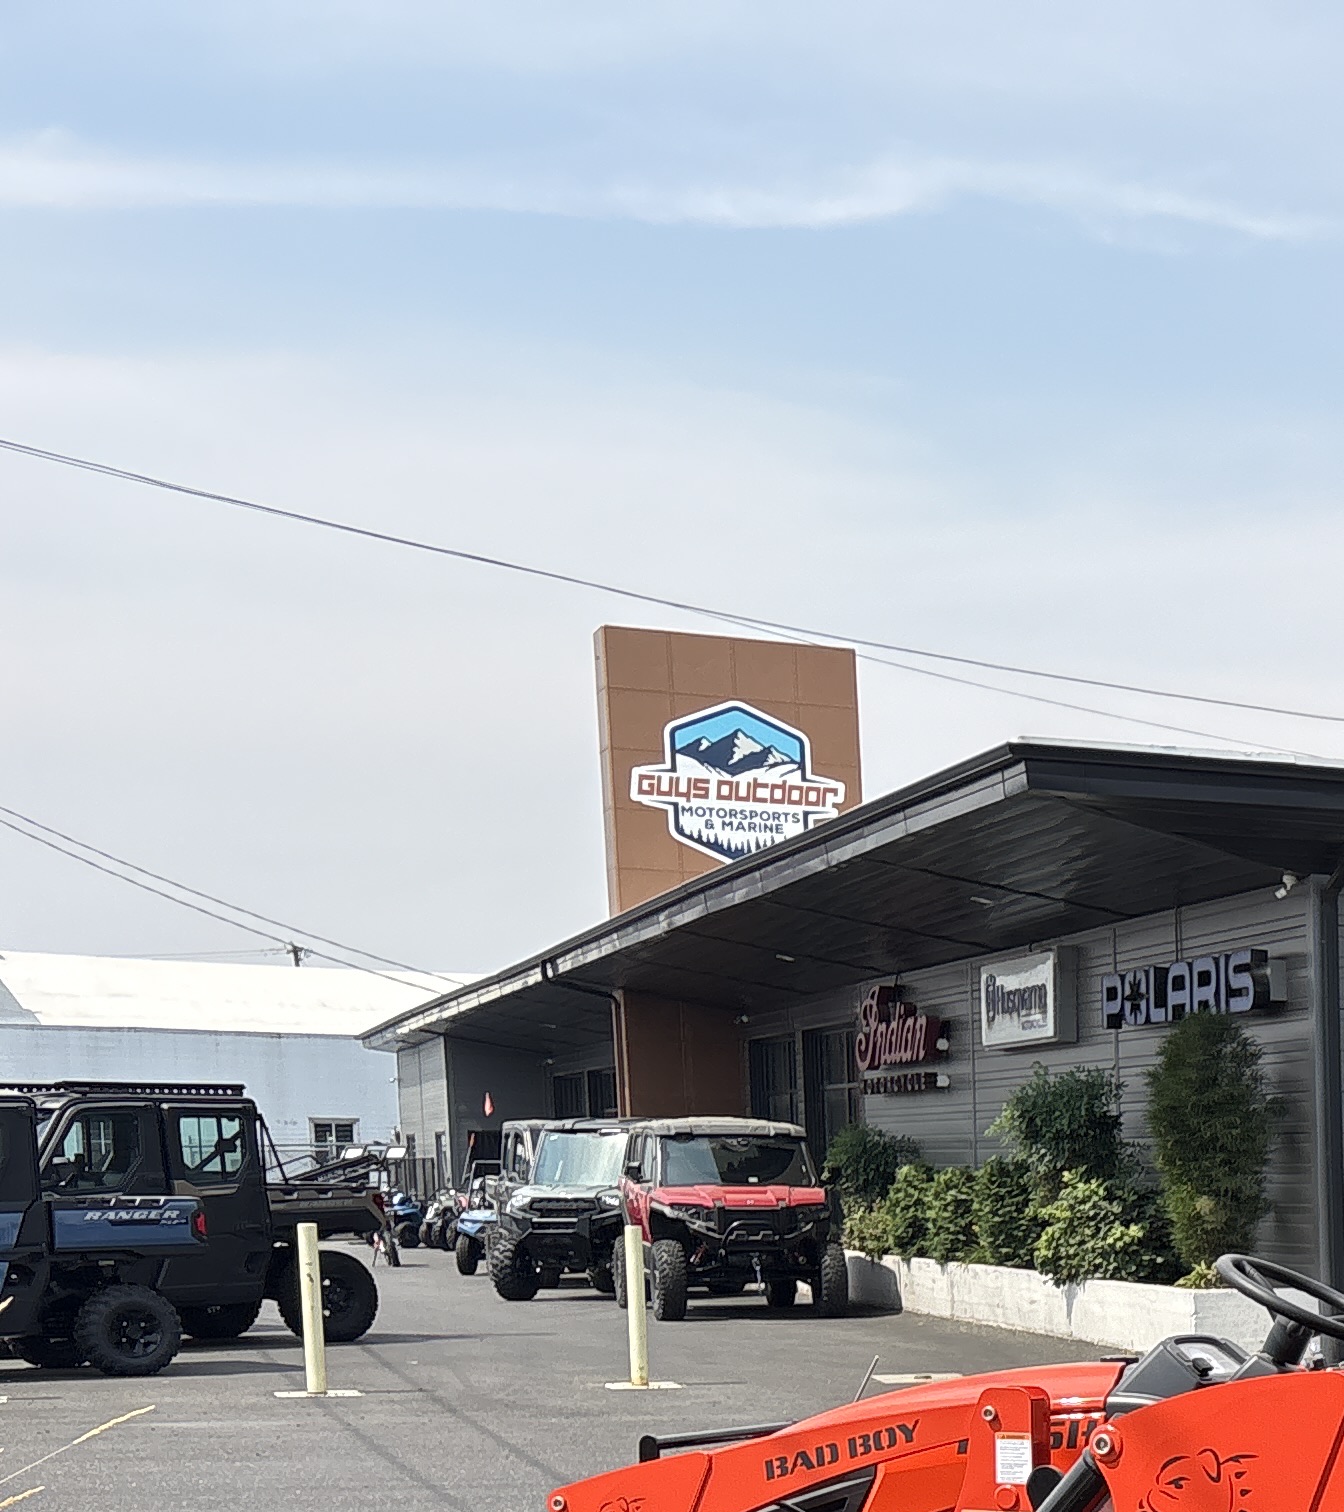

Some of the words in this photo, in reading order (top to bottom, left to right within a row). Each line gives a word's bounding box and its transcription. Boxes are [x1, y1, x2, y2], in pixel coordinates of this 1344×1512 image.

[680, 806, 801, 823] MOTORSPORTS
[704, 819, 715, 830] &
[721, 821, 784, 835] MARINE
[1103, 951, 1254, 1029] POLARIS
[855, 985, 927, 1072] Indian
[83, 1209, 180, 1221] RANGER
[764, 1443, 840, 1482] BAD
[847, 1418, 921, 1459] BOY
